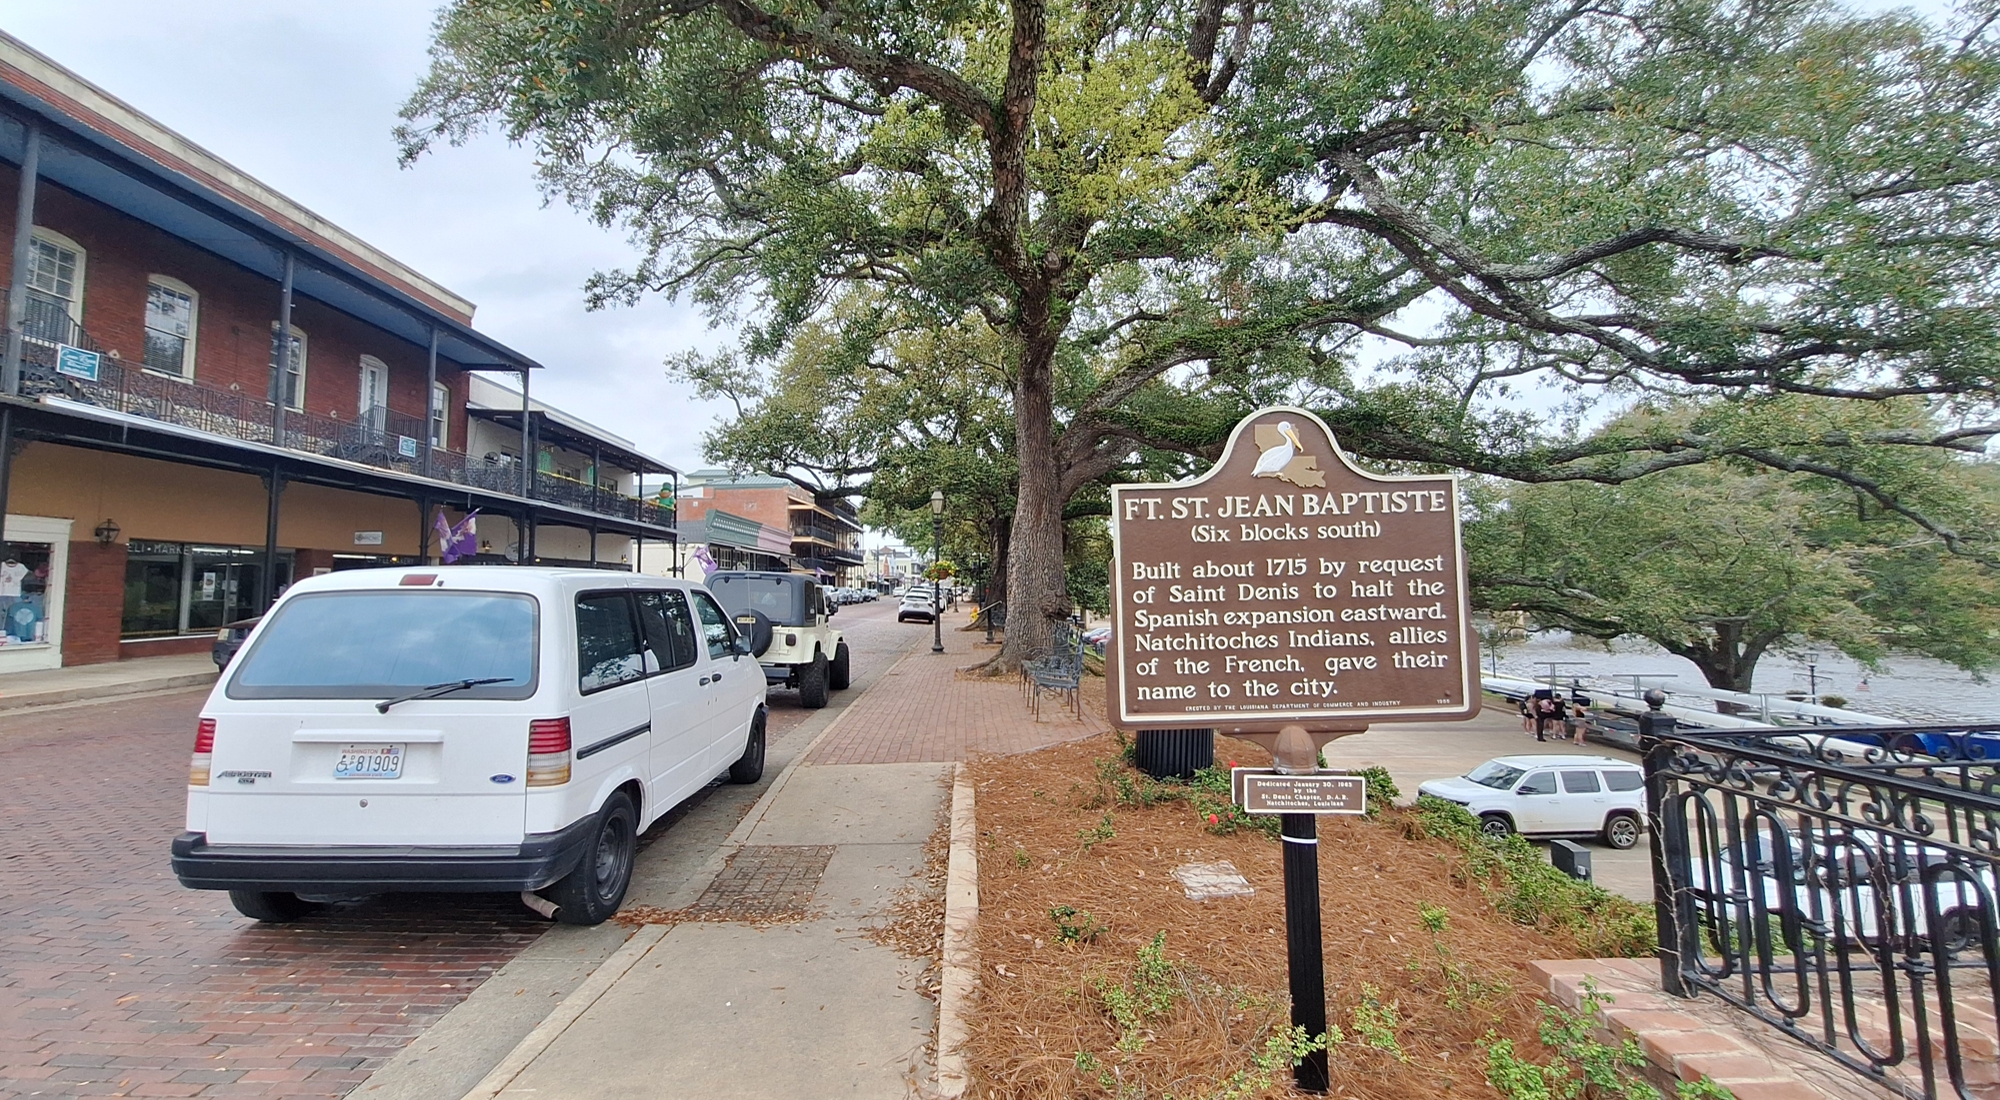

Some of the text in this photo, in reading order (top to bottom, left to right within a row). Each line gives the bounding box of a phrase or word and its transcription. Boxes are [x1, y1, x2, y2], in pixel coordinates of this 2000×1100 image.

[1124, 490, 1447, 521] FT. ST. JEAN BAPTISTE
[1191, 519, 1381, 543] (Six blocks south)
[1132, 554, 1444, 580] Built about 1715 by request
[1132, 578, 1446, 604] of Saint Denis to halt the
[1134, 601, 1447, 629] Spanish expansion eastward.
[1134, 629, 1279, 652] Natchitoches
[1388, 626, 1448, 645] allies
[1136, 657, 1160, 676] of
[1173, 657, 1210, 675] the
[1325, 655, 1378, 677] gave
[1391, 650, 1449, 669] their
[1137, 677, 1338, 701] name to the city.
[355, 755, 400, 772] 81909
[1256, 780, 1291, 788] Dedicated
[1293, 780, 1320, 789] January
